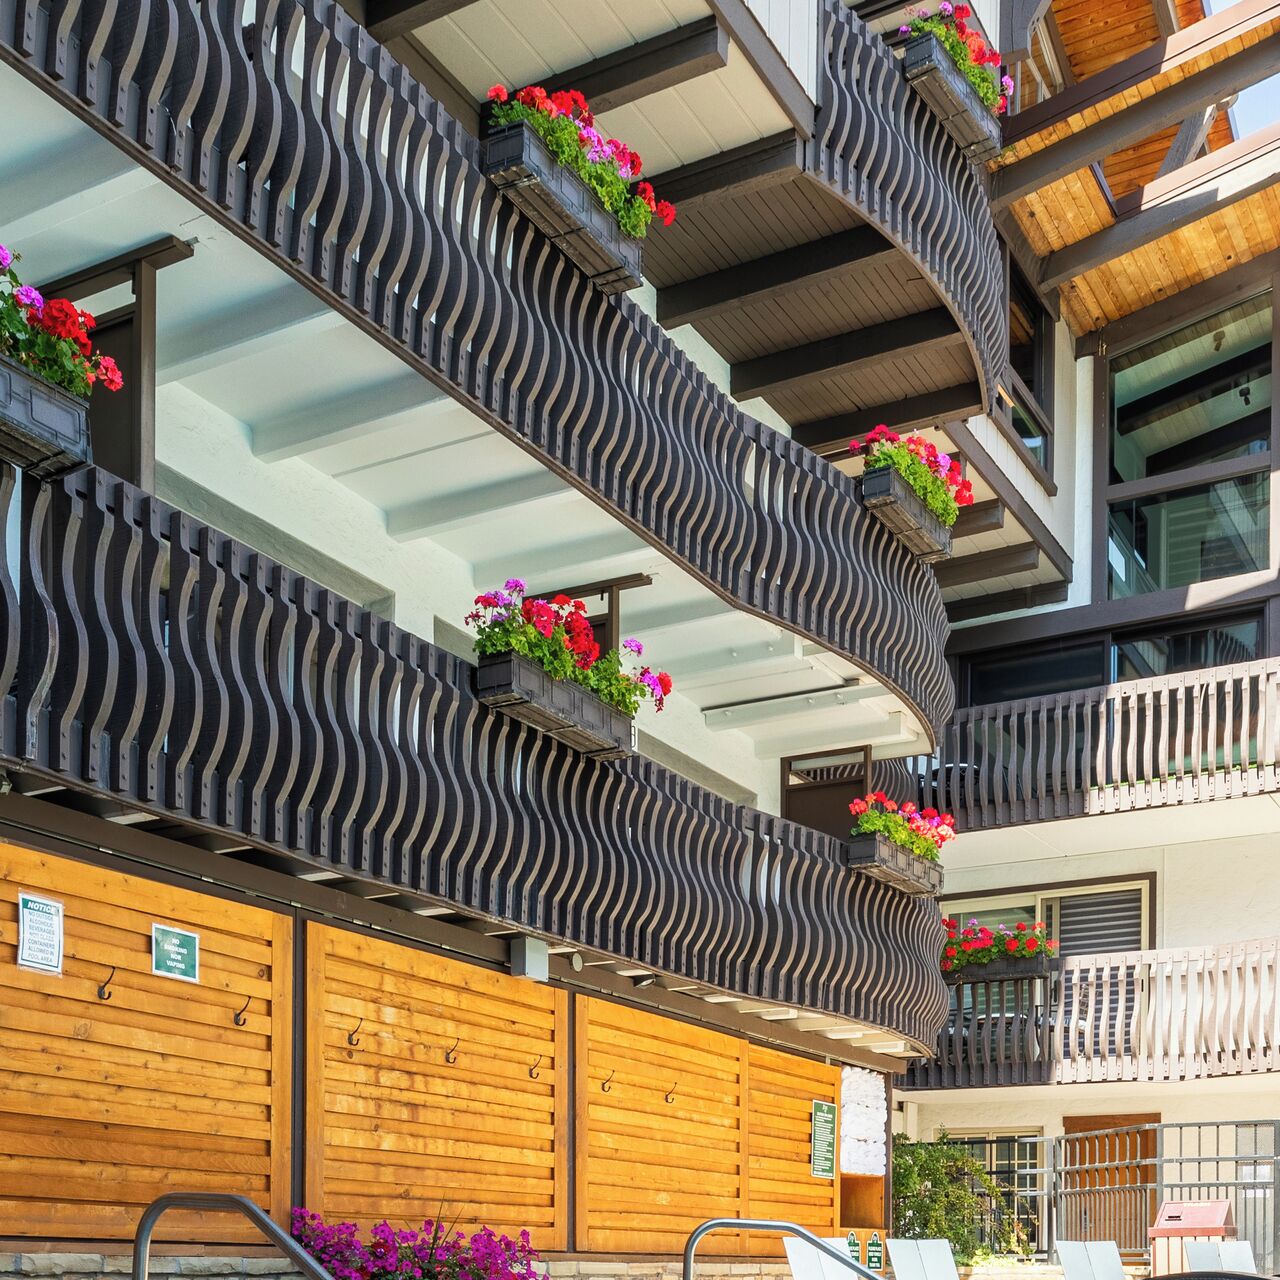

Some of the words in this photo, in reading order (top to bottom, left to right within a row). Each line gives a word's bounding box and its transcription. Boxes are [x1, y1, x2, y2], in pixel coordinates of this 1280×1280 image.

[27, 901, 57, 914] NOTICE
[29, 924, 55, 935] BEVERAGES
[28, 938, 55, 949] CONTAINERS
[28, 945, 49, 955] ALLOWED
[164, 944, 187, 954] SMOKING
[166, 960, 186, 969] VAPING
